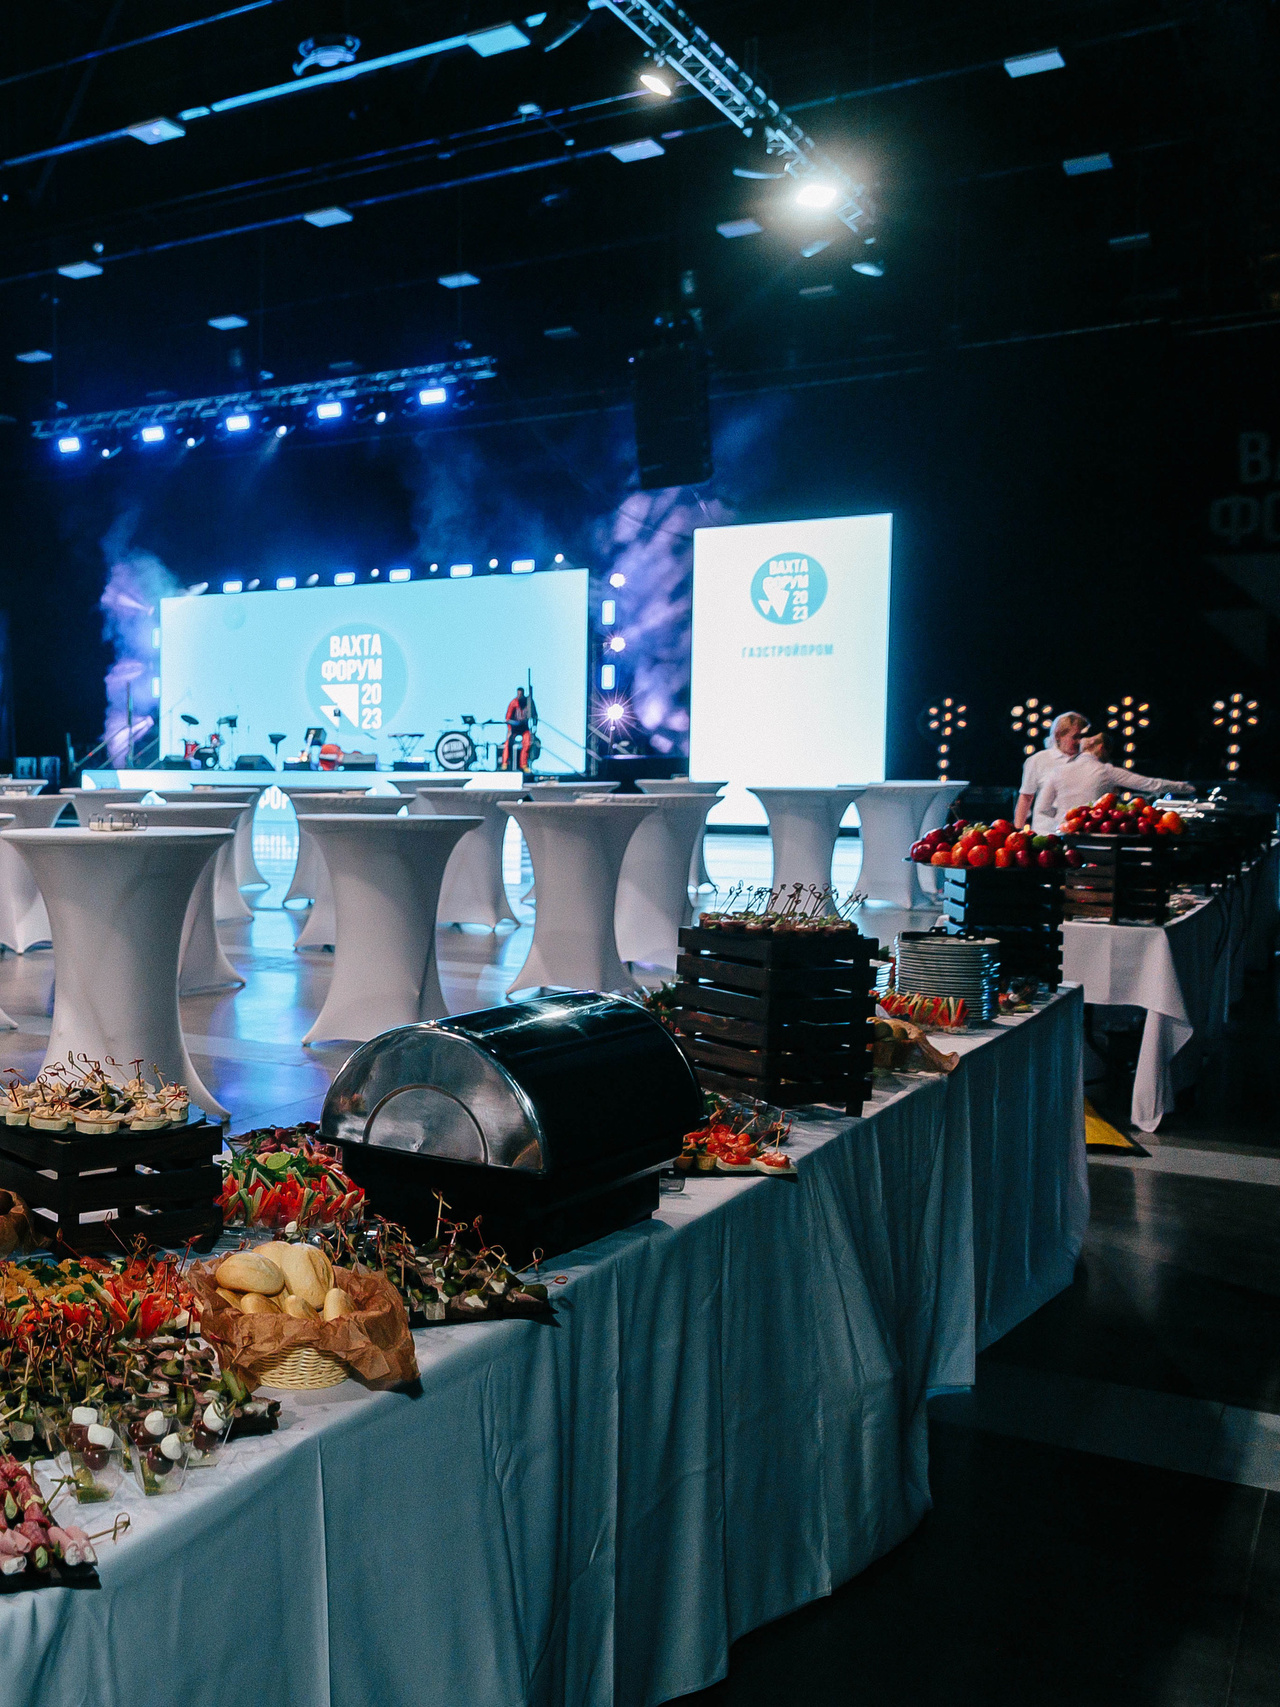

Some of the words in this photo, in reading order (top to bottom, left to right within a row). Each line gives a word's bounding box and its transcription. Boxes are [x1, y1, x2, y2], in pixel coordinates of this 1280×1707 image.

[768, 558, 808, 575] ВАХТА
[792, 590, 808, 605] 20
[330, 633, 382, 658] ВАХТА
[742, 643, 833, 658] ГАЗСТРОЙПРОМ
[321, 658, 382, 682] ФОРУМ
[361, 683, 382, 705] 20
[361, 707, 382, 730] 23
